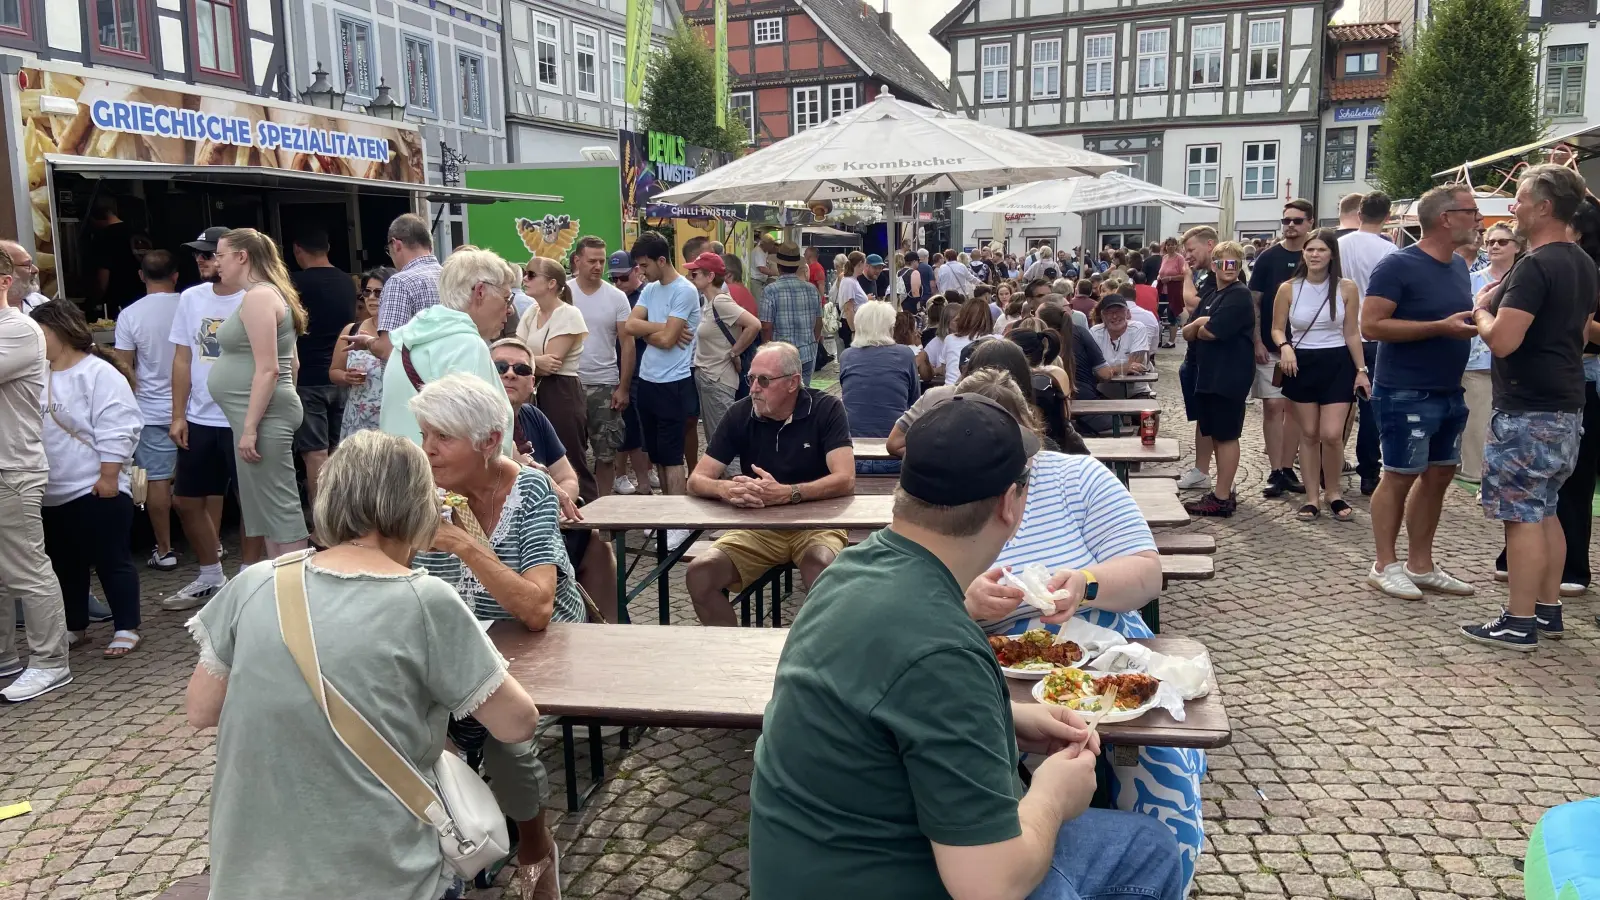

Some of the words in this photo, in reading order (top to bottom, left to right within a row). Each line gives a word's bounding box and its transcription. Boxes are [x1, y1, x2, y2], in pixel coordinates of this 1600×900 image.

[93, 100, 251, 144] GRIECHISCHE
[656, 162, 696, 183] TWISTER
[843, 156, 965, 171] Krombacher
[671, 206, 698, 216] CHILLI
[701, 208, 737, 217] TWISTER
